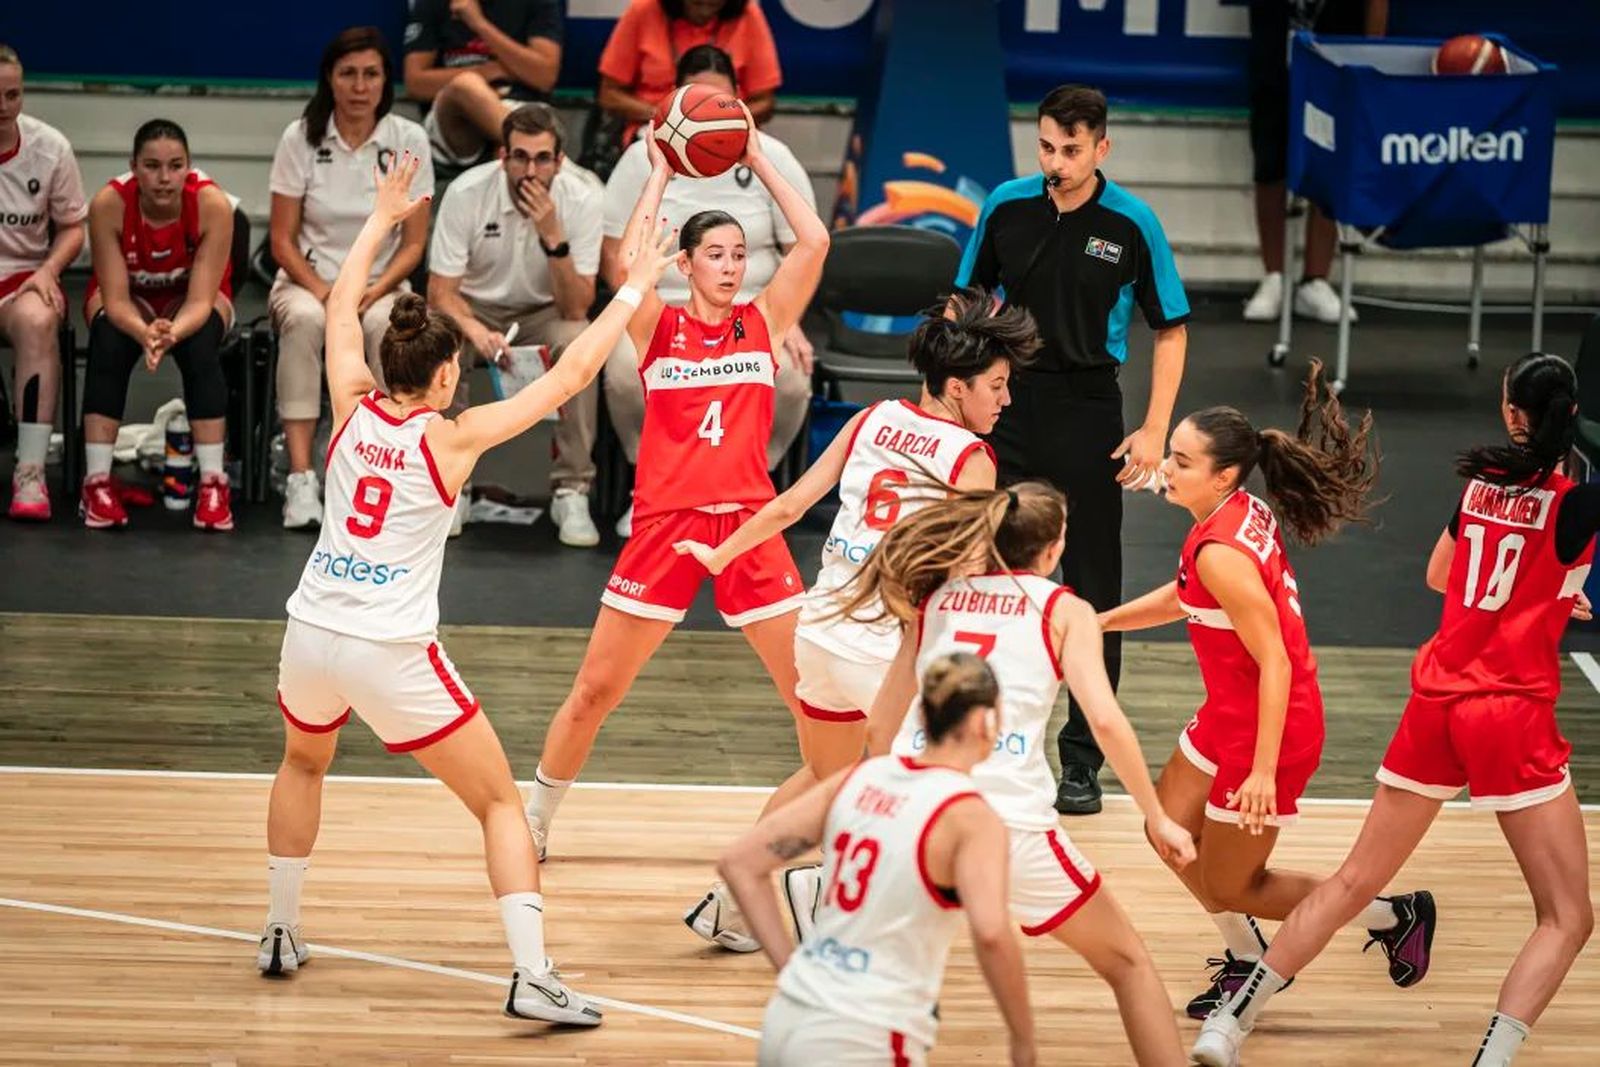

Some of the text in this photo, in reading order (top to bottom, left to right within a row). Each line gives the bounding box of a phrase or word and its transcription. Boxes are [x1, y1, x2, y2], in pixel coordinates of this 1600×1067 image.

[1381, 126, 1524, 165] molten
[697, 400, 725, 447] 4
[345, 475, 394, 539] 9
[863, 468, 909, 532] 6
[1462, 523, 1527, 612] 10
[938, 590, 1029, 617] ZUBIAGA
[824, 832, 879, 912] 13
